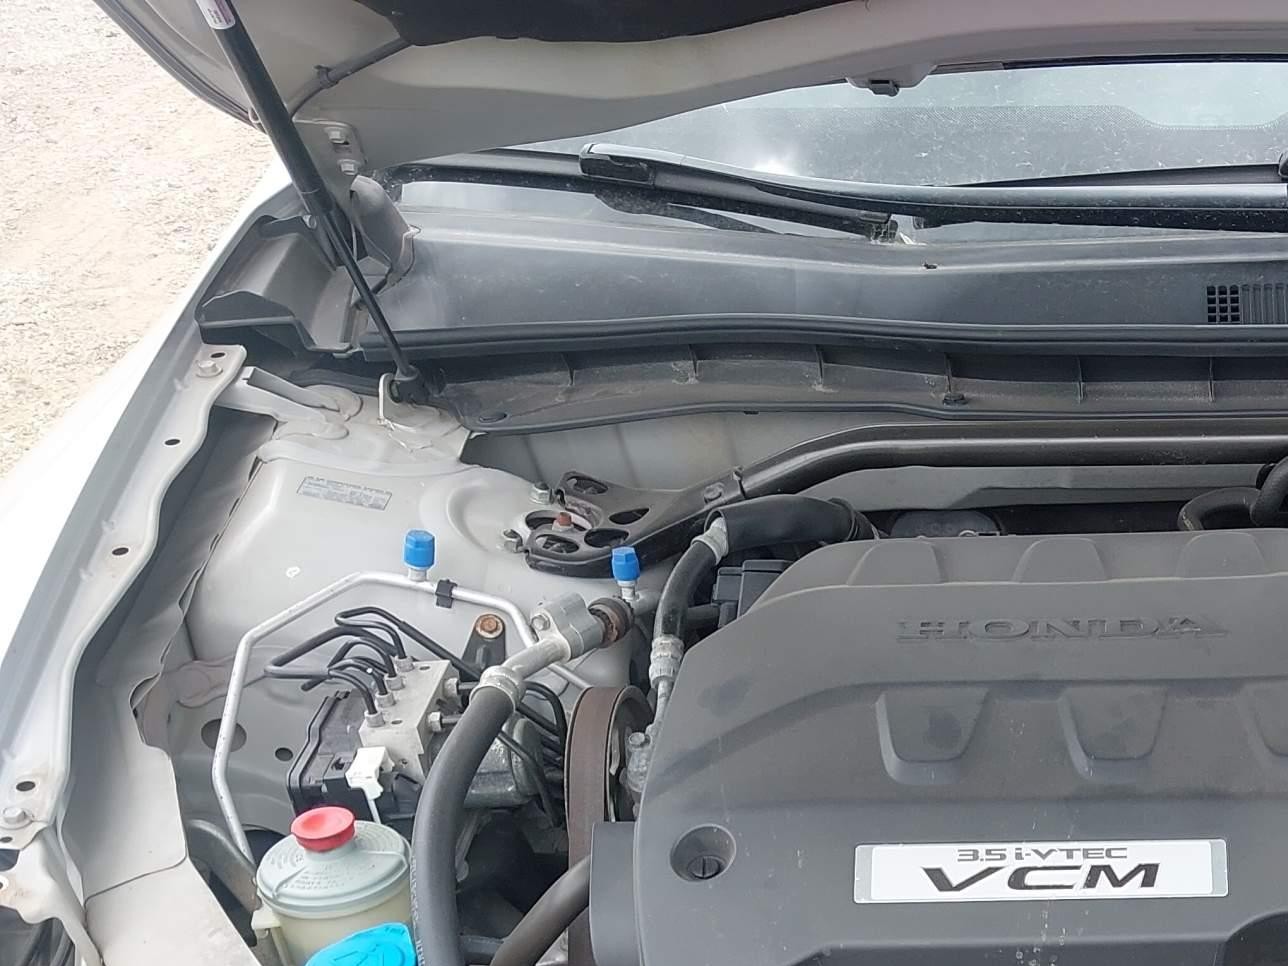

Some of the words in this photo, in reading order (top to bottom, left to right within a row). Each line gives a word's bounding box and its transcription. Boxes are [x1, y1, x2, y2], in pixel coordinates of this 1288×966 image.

[896, 617, 1231, 643] HONDA
[957, 848, 1006, 862] 3.5
[1014, 847, 1128, 861] i-VTEC
[921, 862, 1161, 892] VCM
